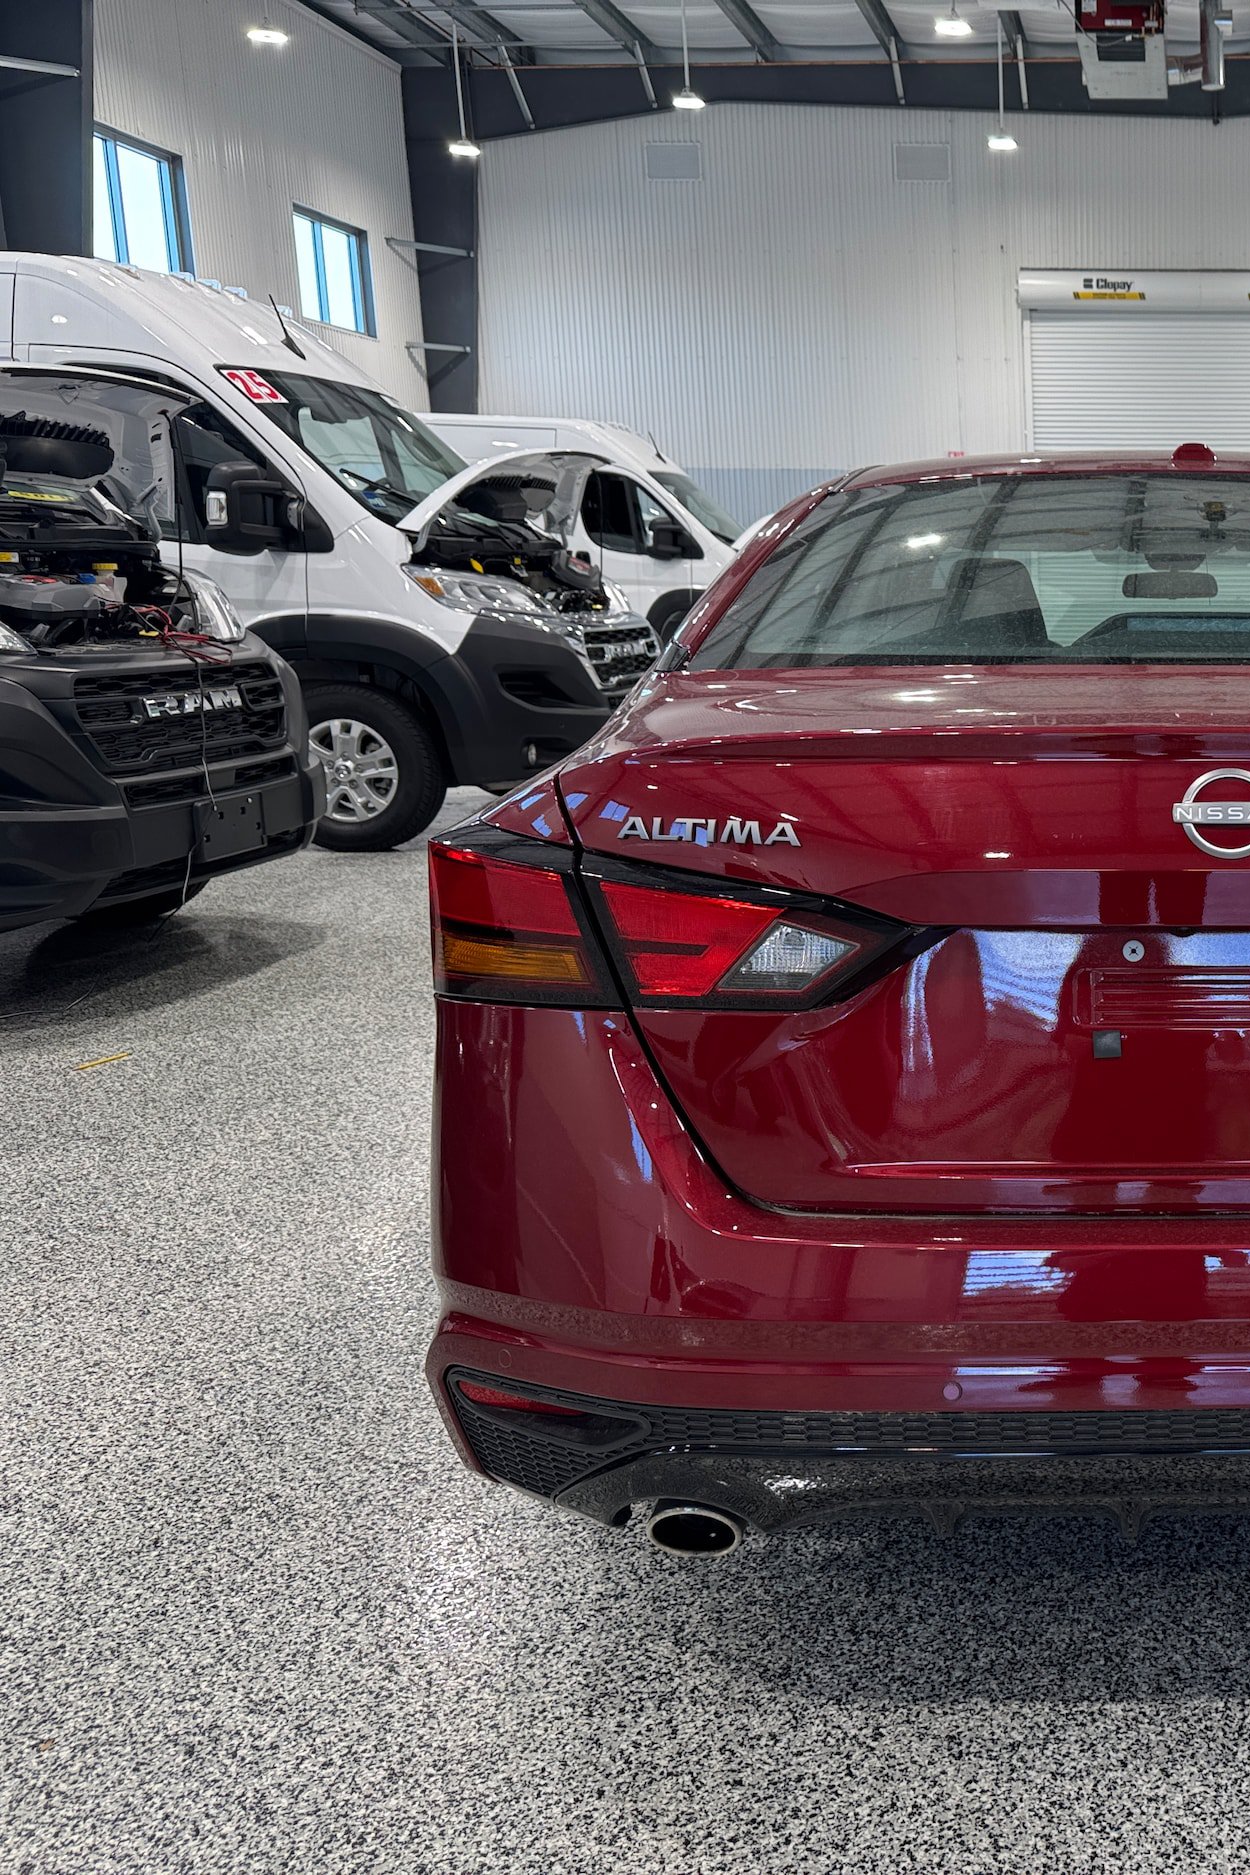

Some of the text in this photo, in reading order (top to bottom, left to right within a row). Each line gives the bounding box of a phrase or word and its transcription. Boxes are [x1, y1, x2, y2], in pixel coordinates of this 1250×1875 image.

[1096, 278, 1133, 292] Clopay
[226, 371, 279, 400] 25
[142, 689, 243, 719] RAM
[616, 816, 802, 848] ALTIMA
